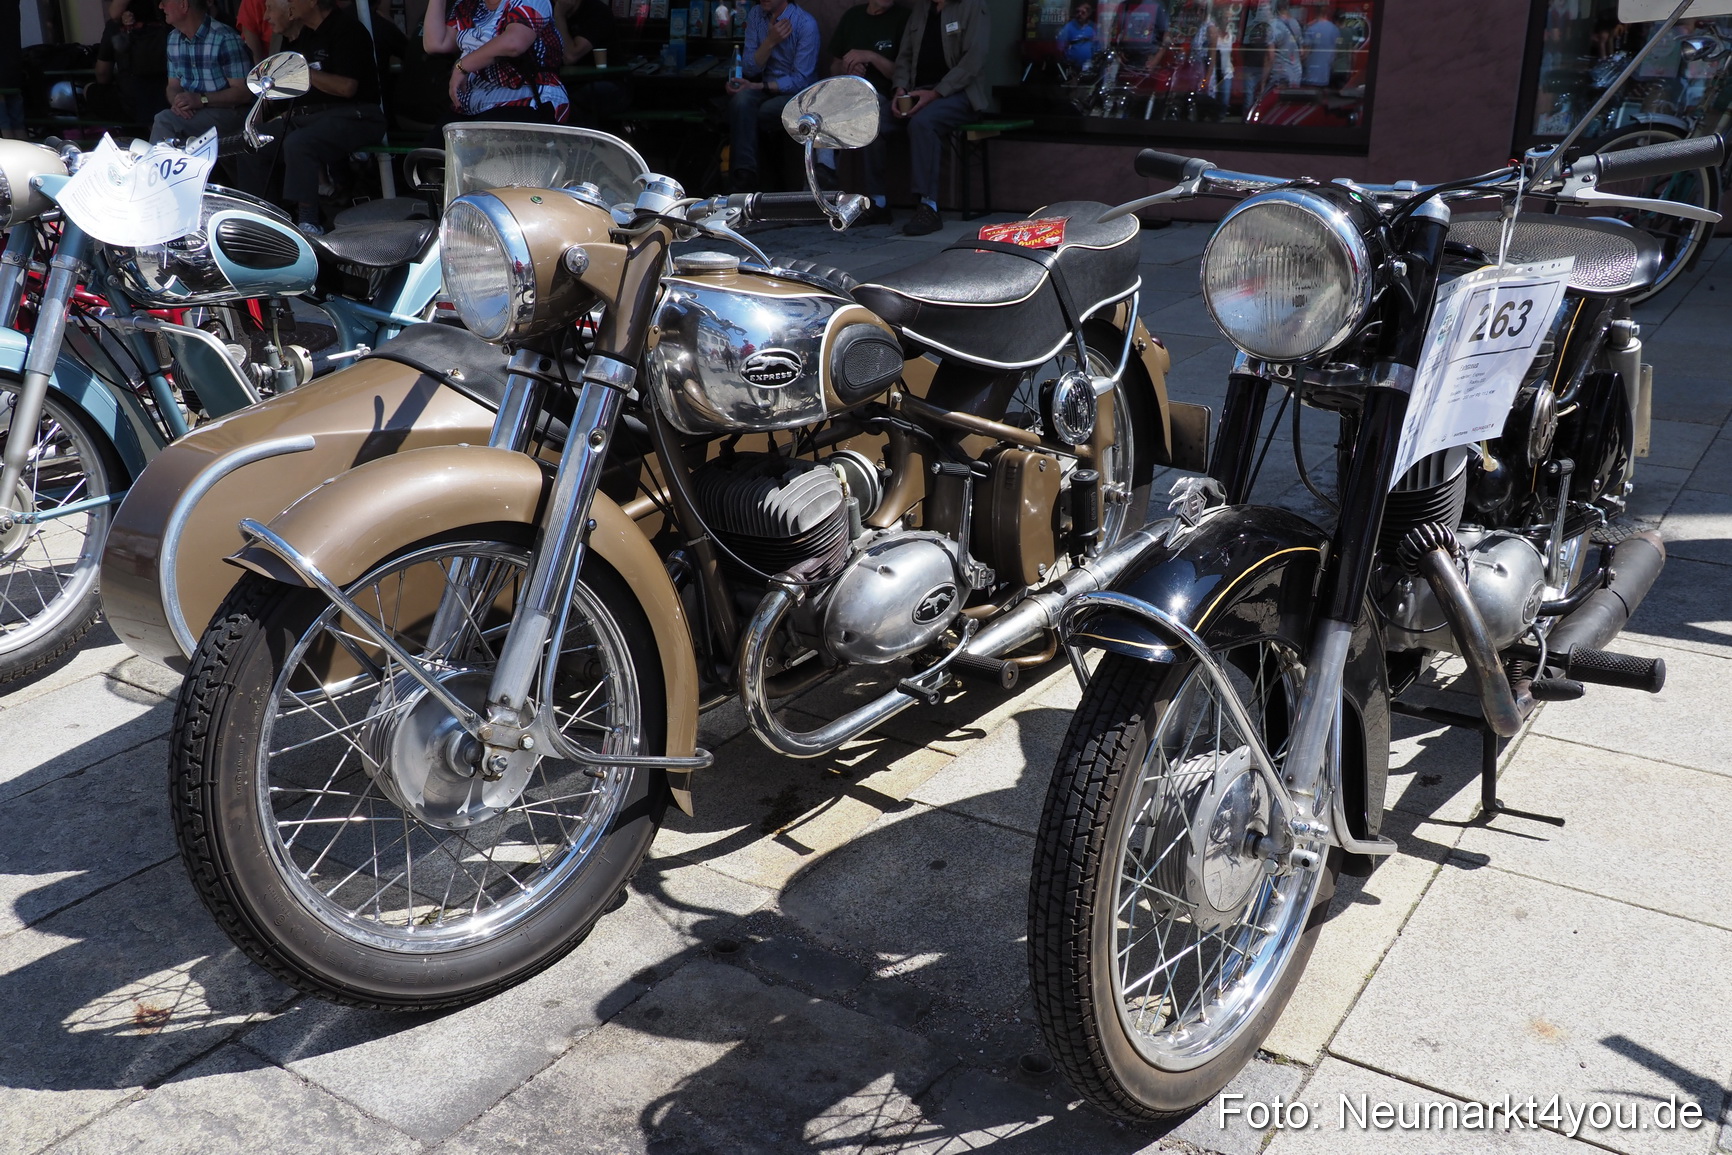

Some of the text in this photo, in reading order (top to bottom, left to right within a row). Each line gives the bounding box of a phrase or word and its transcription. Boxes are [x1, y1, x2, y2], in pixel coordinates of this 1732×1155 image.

[1223, 0, 1243, 43] SPIC
[147, 157, 191, 187] 605
[1468, 299, 1533, 343] 263
[749, 371, 793, 381] EXPRESS
